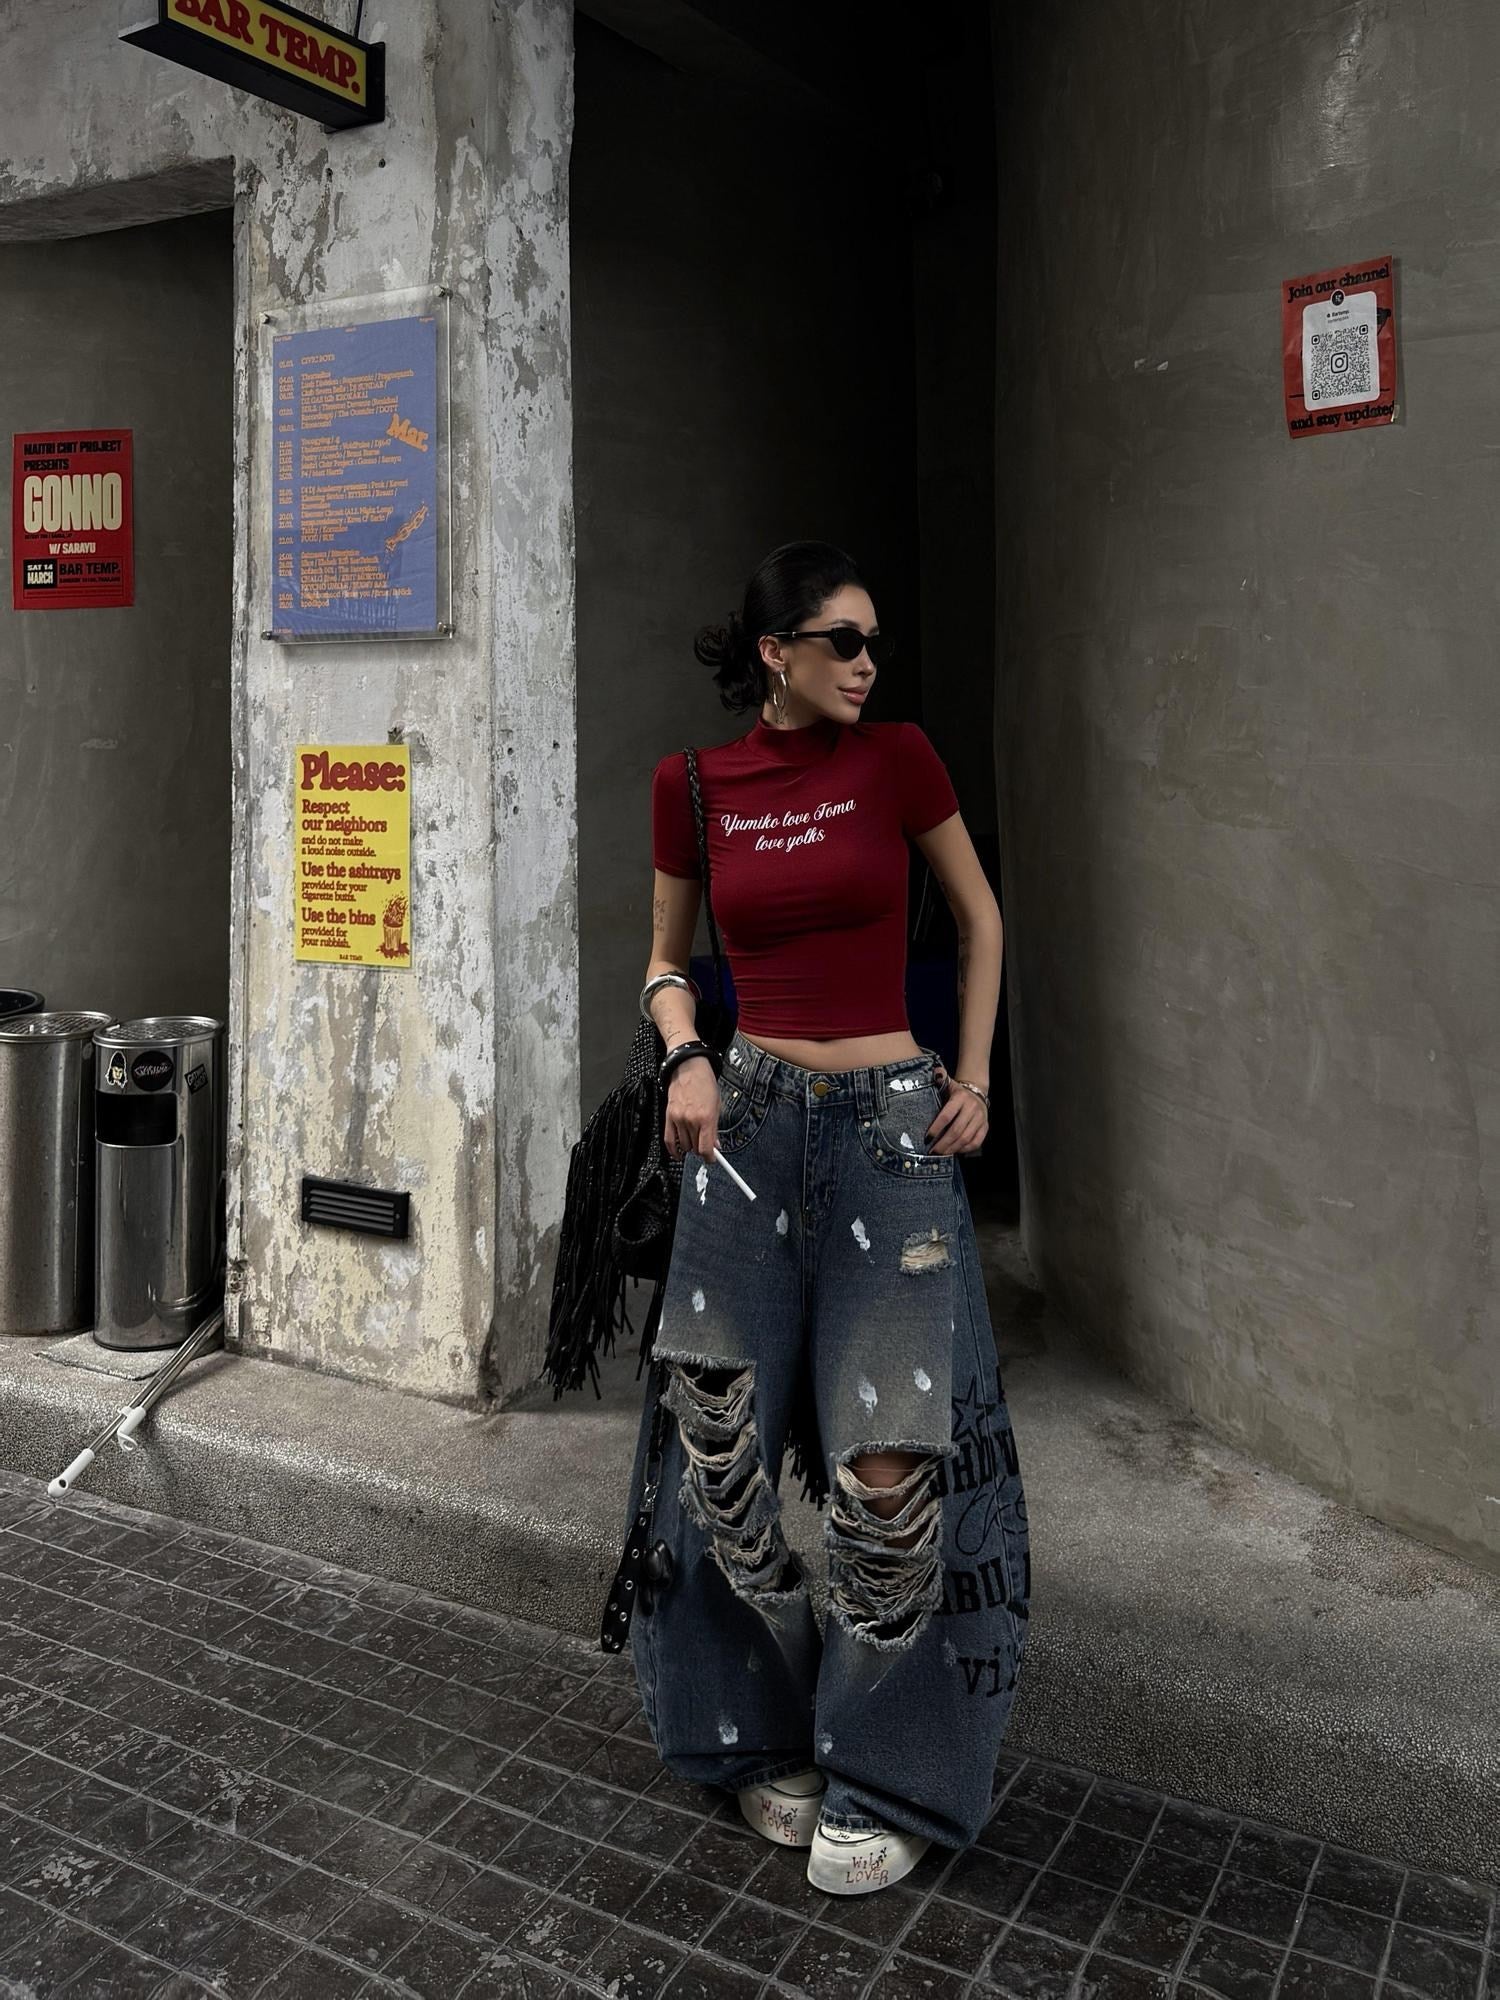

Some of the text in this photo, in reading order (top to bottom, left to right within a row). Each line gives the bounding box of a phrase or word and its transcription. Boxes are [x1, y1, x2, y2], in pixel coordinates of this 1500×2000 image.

[259, 13, 361, 94] TEMP.
[1287, 263, 1390, 304] Join our channel
[1291, 400, 1395, 430] and stay updated
[386, 413, 429, 453] Mar.
[24, 458, 69, 472] PRESENTS
[24, 472, 122, 534] GONNO
[49, 542, 96, 555] W/ SARAYU
[27, 571, 54, 585] MARCH
[60, 562, 83, 576] BAR
[301, 750, 406, 792] Please:
[302, 799, 350, 818] Respect
[720, 799, 857, 837] Yumiko love Toma
[302, 816, 387, 837] our neighbors
[302, 835, 364, 846] and do not make
[755, 826, 826, 853] love yolks
[302, 845, 376, 857] a loud noise outside.
[301, 861, 401, 884] Use the ashtrays
[302, 880, 368, 894] provided for your
[302, 890, 333, 902] cigarette
[301, 907, 376, 926] Use the bins
[302, 927, 348, 938] provided for
[301, 937, 351, 949] your rubbish.
[760, 1809, 799, 1843] LOVER
[846, 1869, 889, 1886] LOVER
